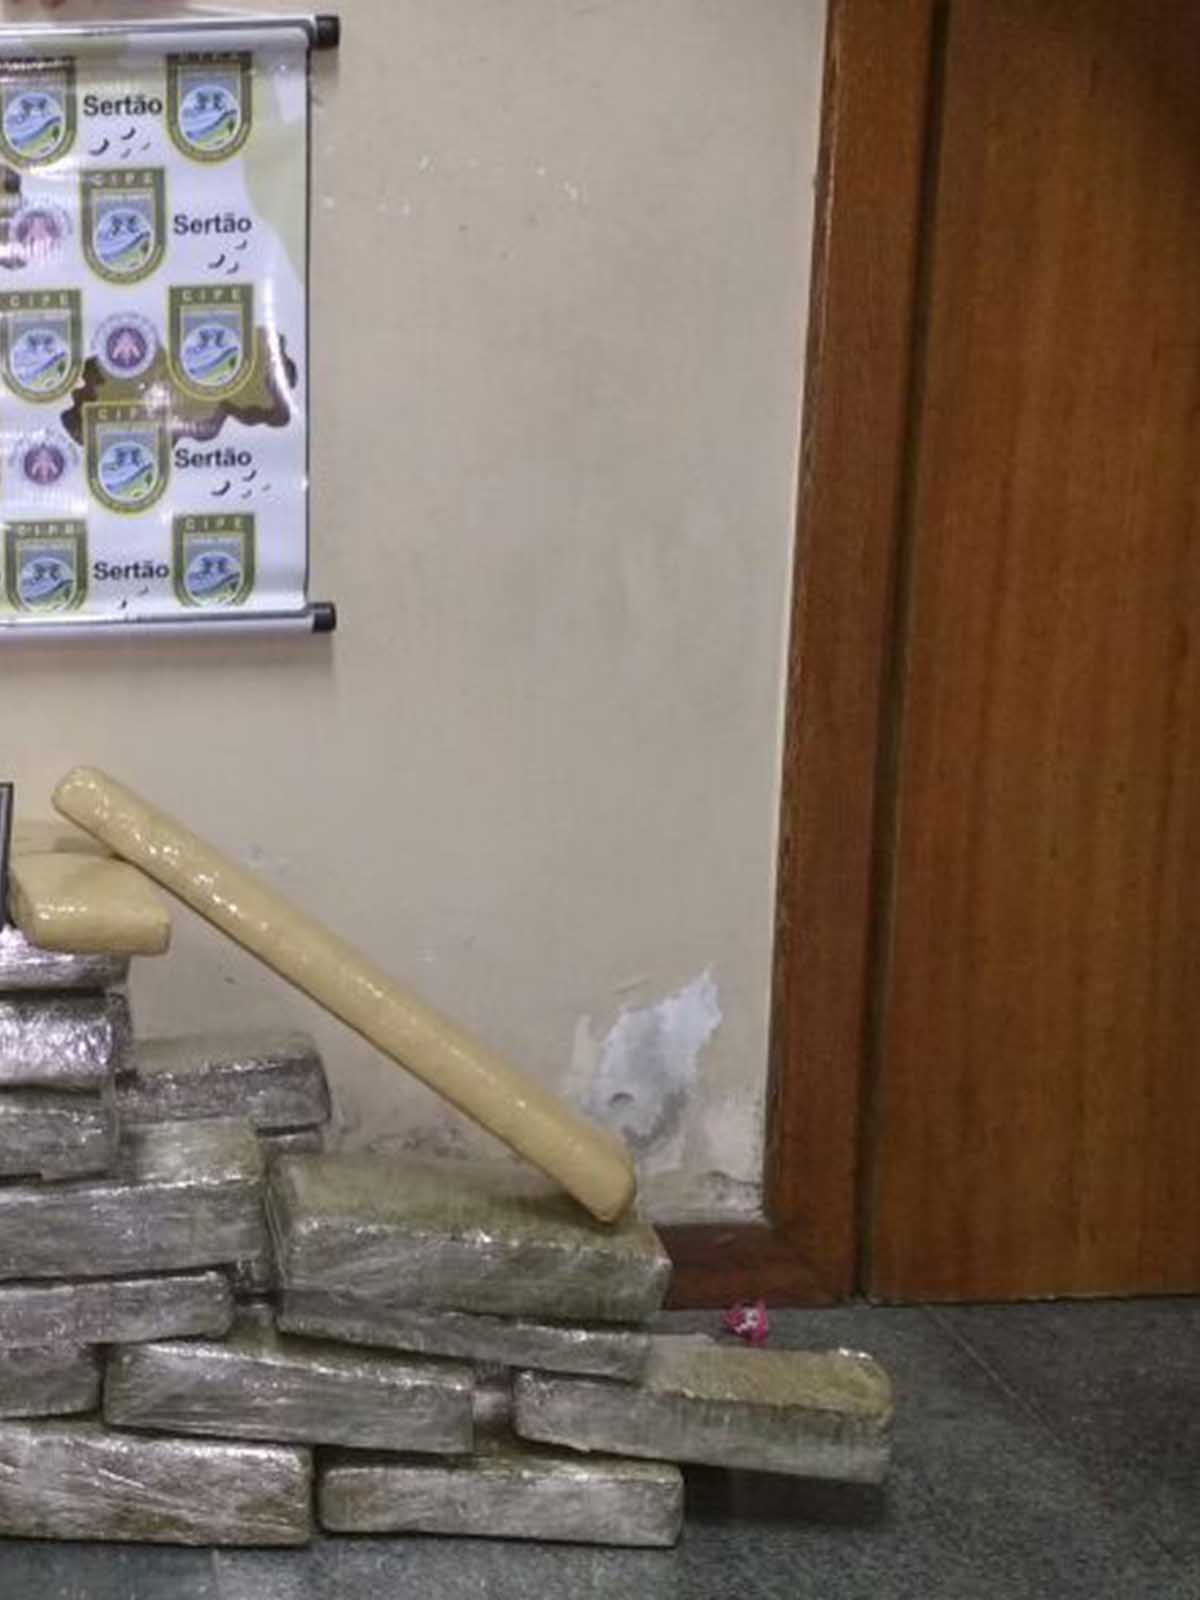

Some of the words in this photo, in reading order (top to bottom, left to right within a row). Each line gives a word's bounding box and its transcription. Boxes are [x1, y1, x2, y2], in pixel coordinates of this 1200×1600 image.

[82, 93, 163, 117] Sertão
[173, 212, 253, 235] Sertão
[181, 287, 242, 301] CIPE
[174, 448, 252, 468] Sertão
[93, 560, 170, 581] Sertão
